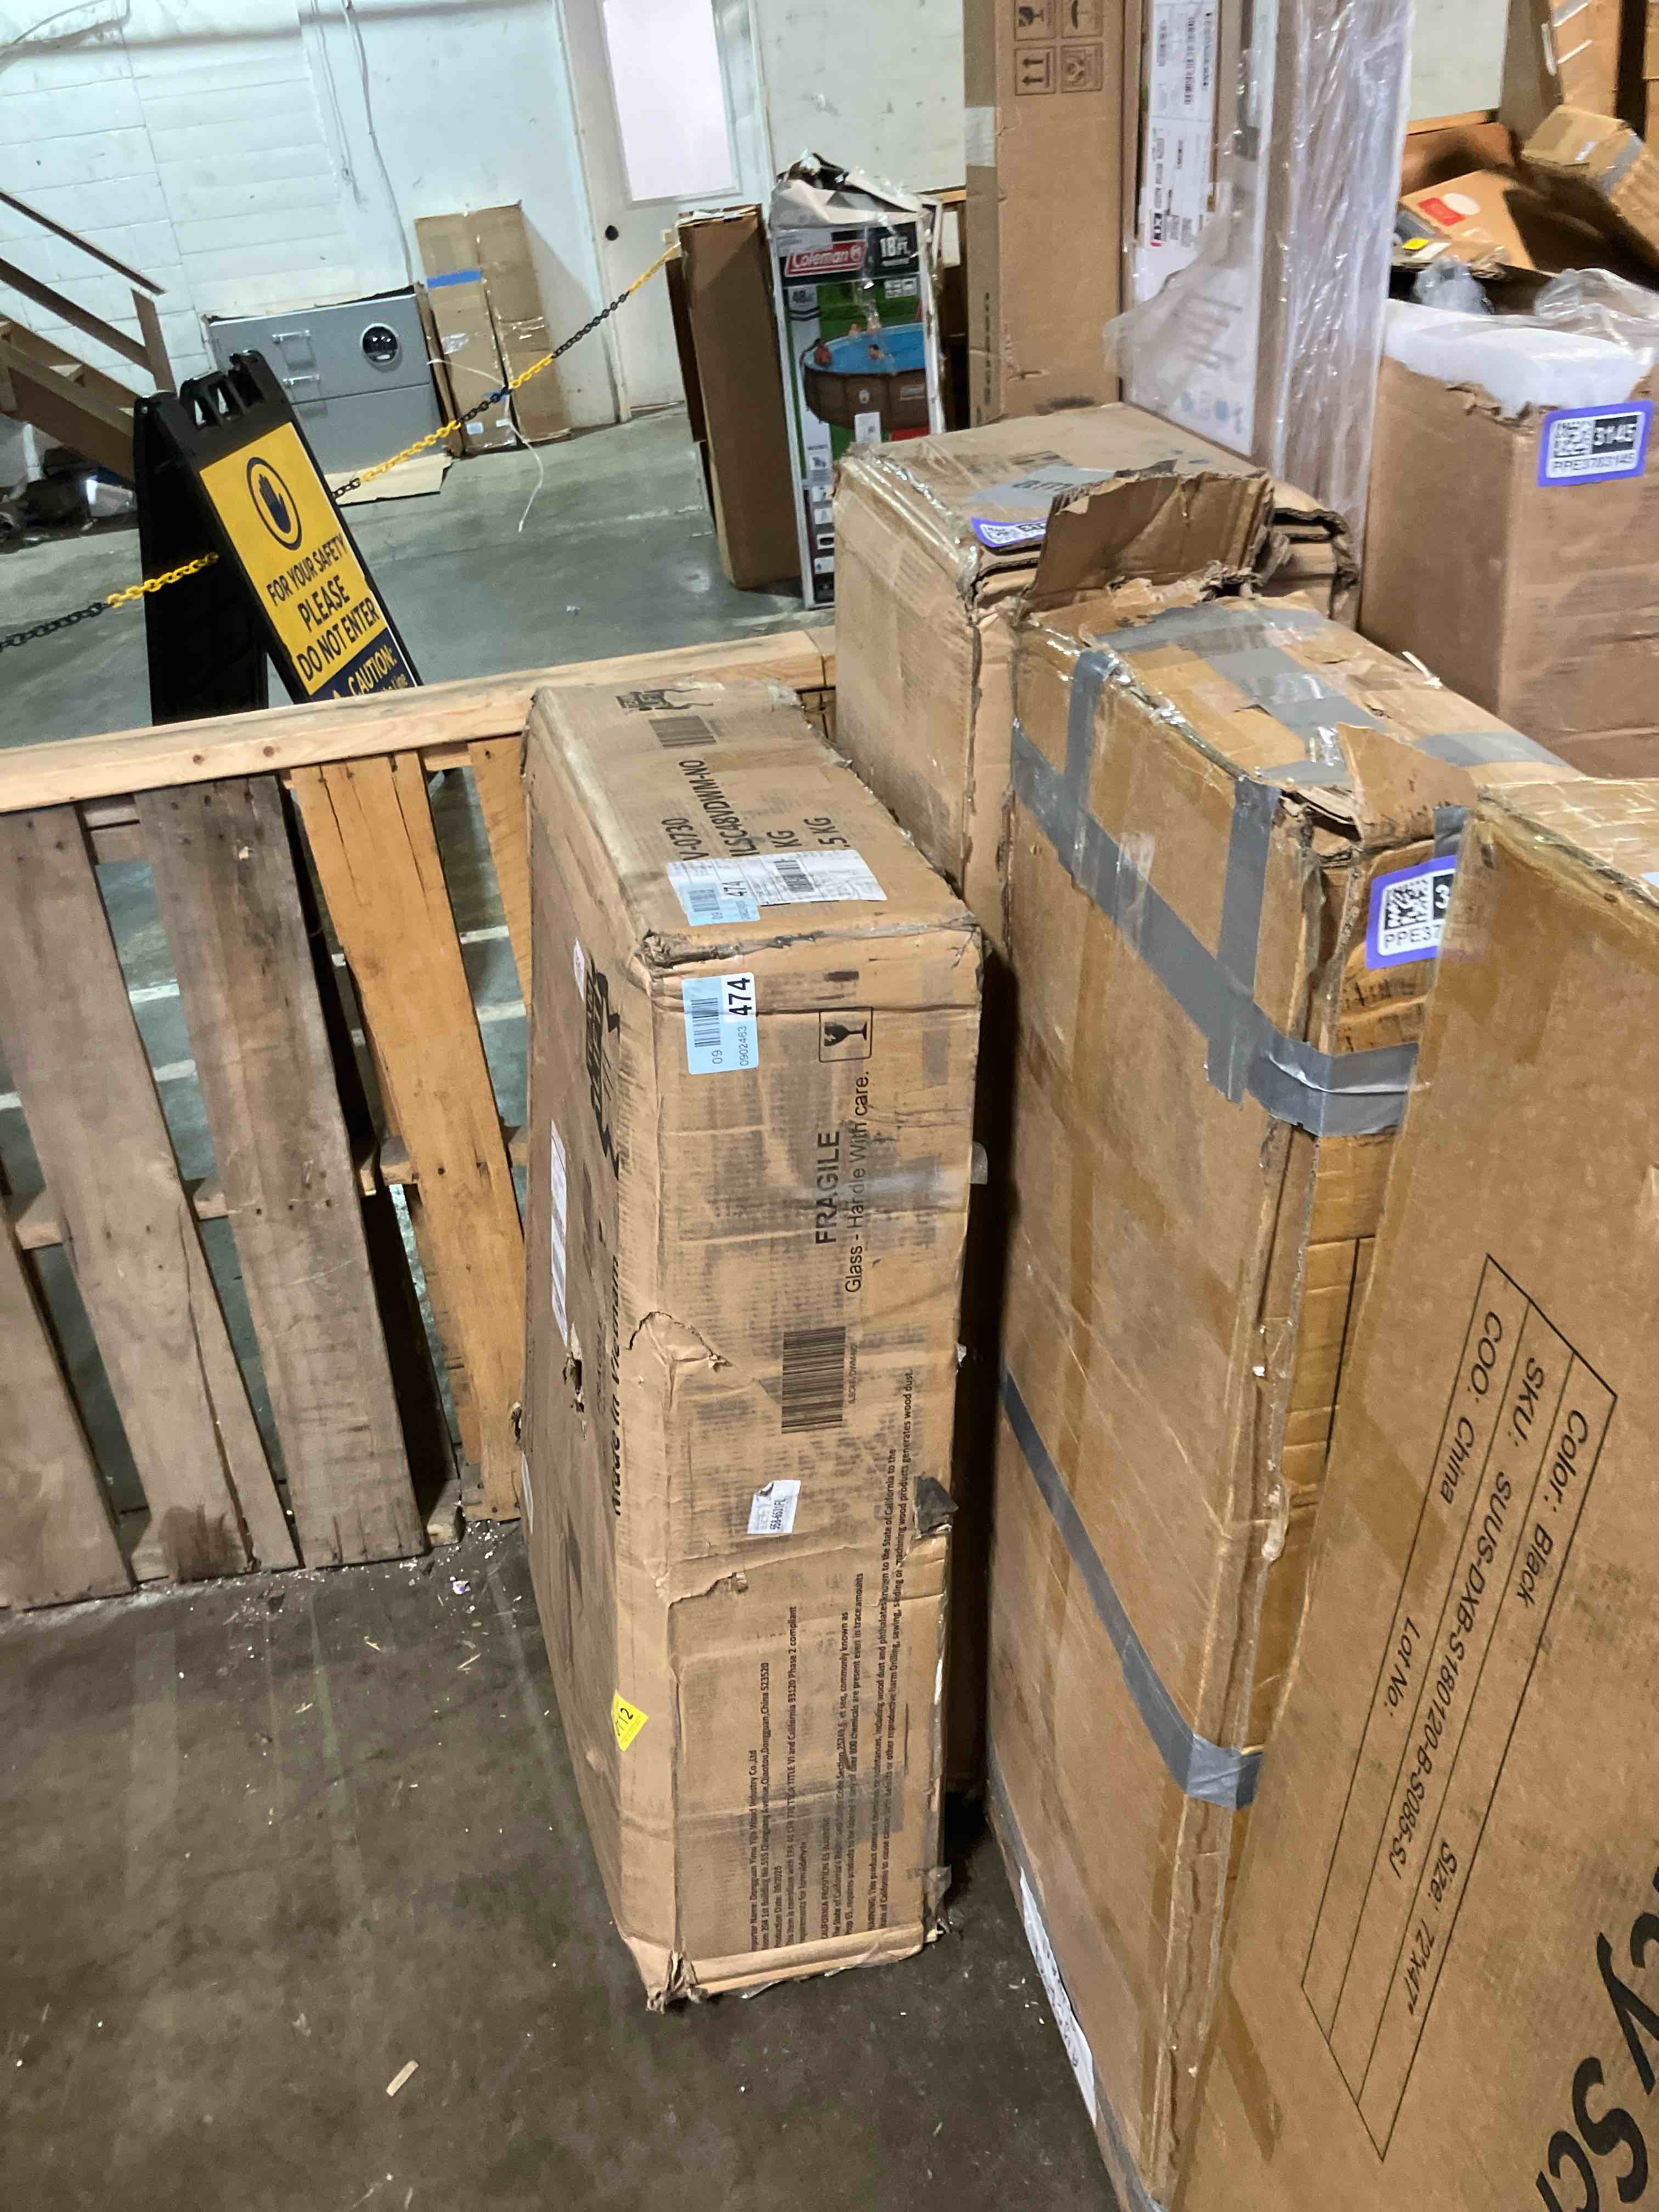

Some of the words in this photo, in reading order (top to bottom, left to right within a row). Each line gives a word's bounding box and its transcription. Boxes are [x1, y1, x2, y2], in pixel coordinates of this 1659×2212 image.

[792, 250, 849, 269] Coleman
[266, 574, 294, 606] FOR
[286, 556, 318, 591] YOUR
[312, 533, 348, 572] SAFETY
[297, 574, 351, 633] PLEASE
[296, 645, 323, 682] DO
[317, 623, 348, 665] NOT
[340, 596, 382, 644] ENTER
[348, 644, 399, 696] CAUTION:
[766, 829, 802, 849] KG
[803, 816, 836, 834] KG
[727, 977, 753, 1015] 474
[712, 1050, 723, 1064] 09
[737, 1025, 749, 1066] 0902463
[853, 1071, 870, 1117] care.
[815, 1130, 840, 1244] FRAGILE
[847, 1168, 866, 1228] Handle
[844, 1245, 863, 1293] Glass
[611, 1255, 619, 1385] Vietnam
[1465, 1311, 1504, 1403] COO:
[902, 1394, 912, 1419] wood
[1508, 1357, 1545, 1448] SKU:
[887, 1449, 896, 1463] the
[901, 1421, 912, 1463] generates
[1438, 1416, 1477, 1504] China
[1544, 1409, 1590, 1513] Color:
[887, 1465, 895, 1474] to
[884, 1476, 896, 1515] California
[898, 1503, 907, 1526] wood
[883, 1529, 891, 1547] State
[884, 1518, 893, 1527] of
[882, 1548, 890, 1560] the
[882, 1562, 889, 1571] to
[1515, 1522, 1555, 1609] Black
[855, 1573, 864, 1607] amounts
[788, 1606, 798, 1646] compliant
[842, 1612, 848, 1621] as
[840, 1623, 848, 1651] known
[878, 1646, 886, 1661] and
[1397, 1616, 1421, 1662] Lot
[760, 1663, 769, 1691] 523520
[788, 1655, 796, 1679] Phase
[839, 1653, 849, 1692] commonly
[853, 1661, 861, 1689] present
[877, 1661, 885, 1678] dust
[888, 1672, 898, 1692] harm
[1388, 1470, 1513, 1880] SUUS-DXB-S180120-B-S085-SJ
[851, 1705, 859, 1739] chemicals
[1427, 1841, 1458, 1910] Size:
